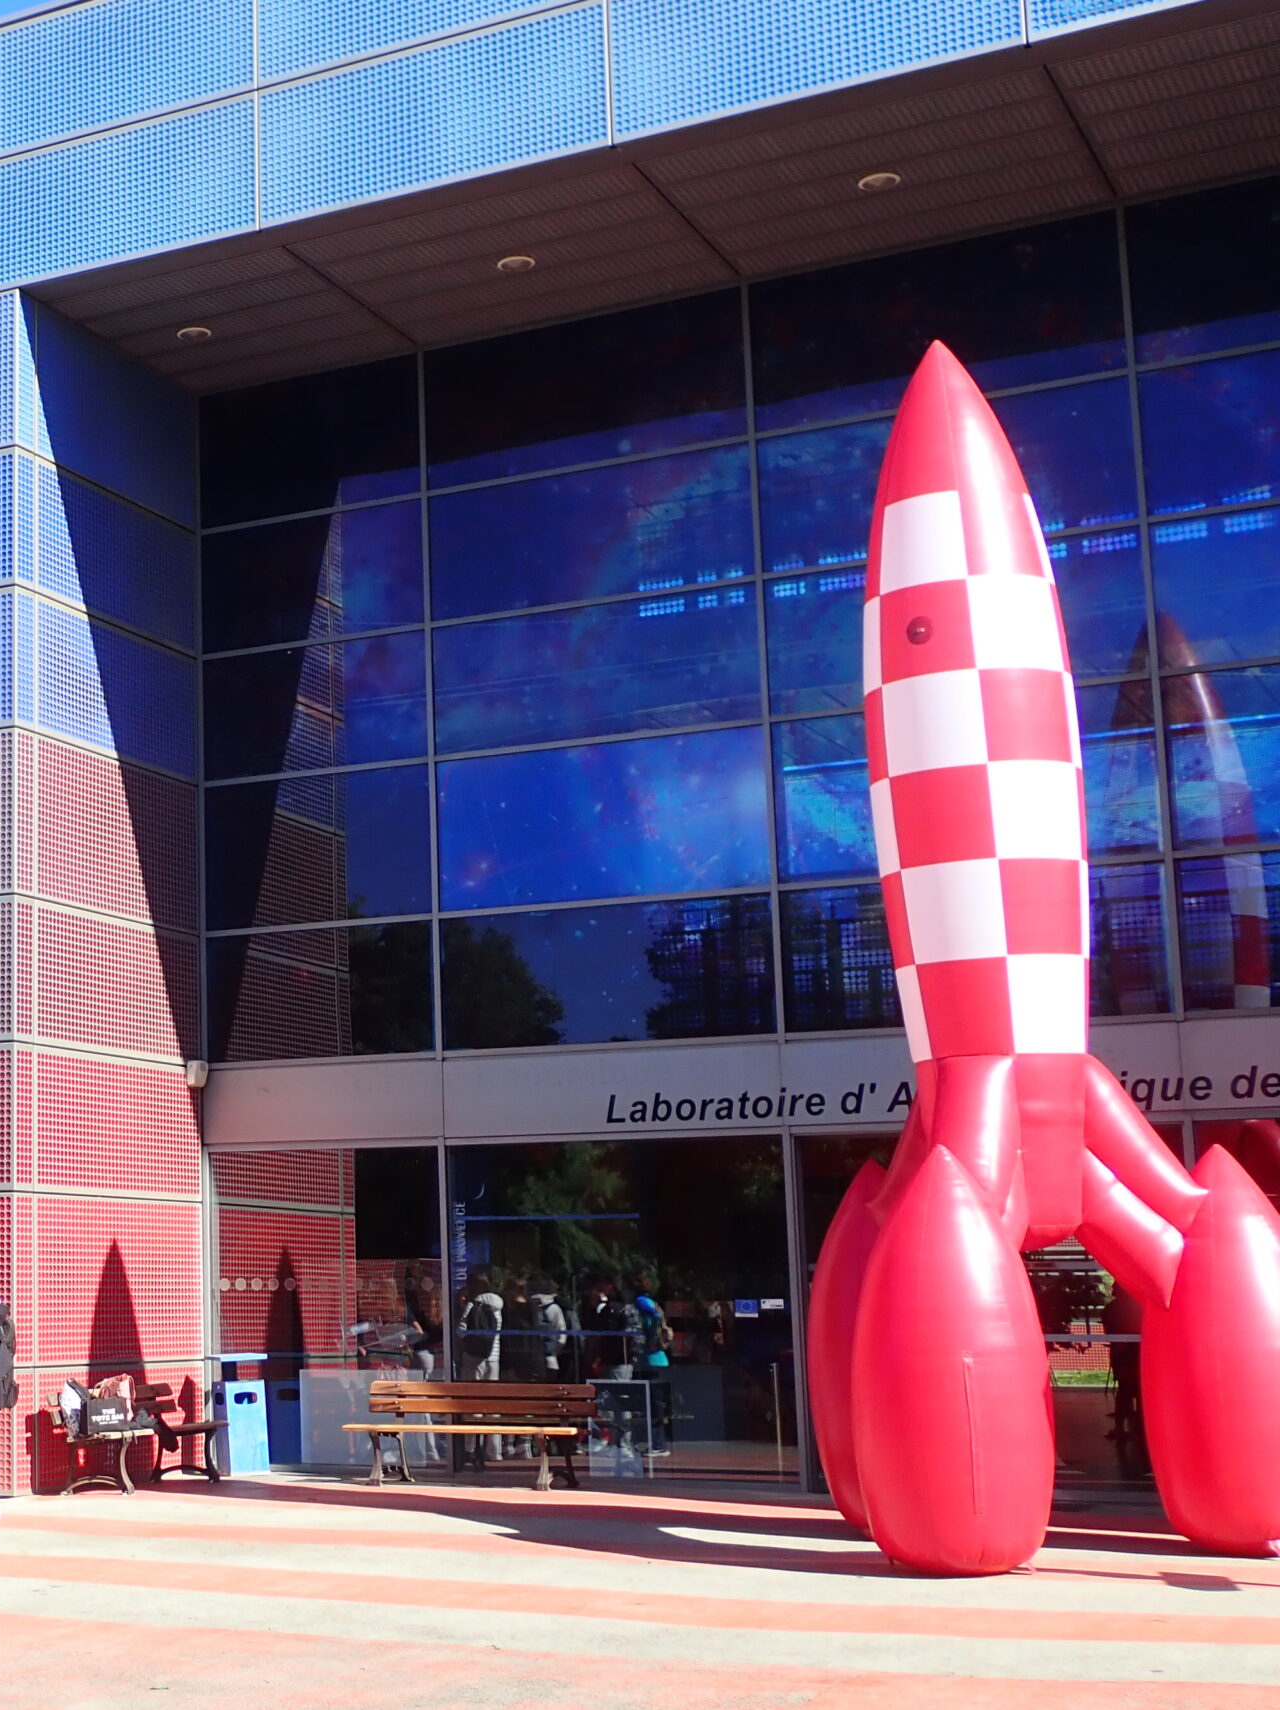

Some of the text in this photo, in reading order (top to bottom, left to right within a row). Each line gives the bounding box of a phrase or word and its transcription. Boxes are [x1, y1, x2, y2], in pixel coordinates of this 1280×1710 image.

[606, 1087, 826, 1123] Laboratoire
[840, 1082, 877, 1115] d'
[1230, 1065, 1280, 1099] de
